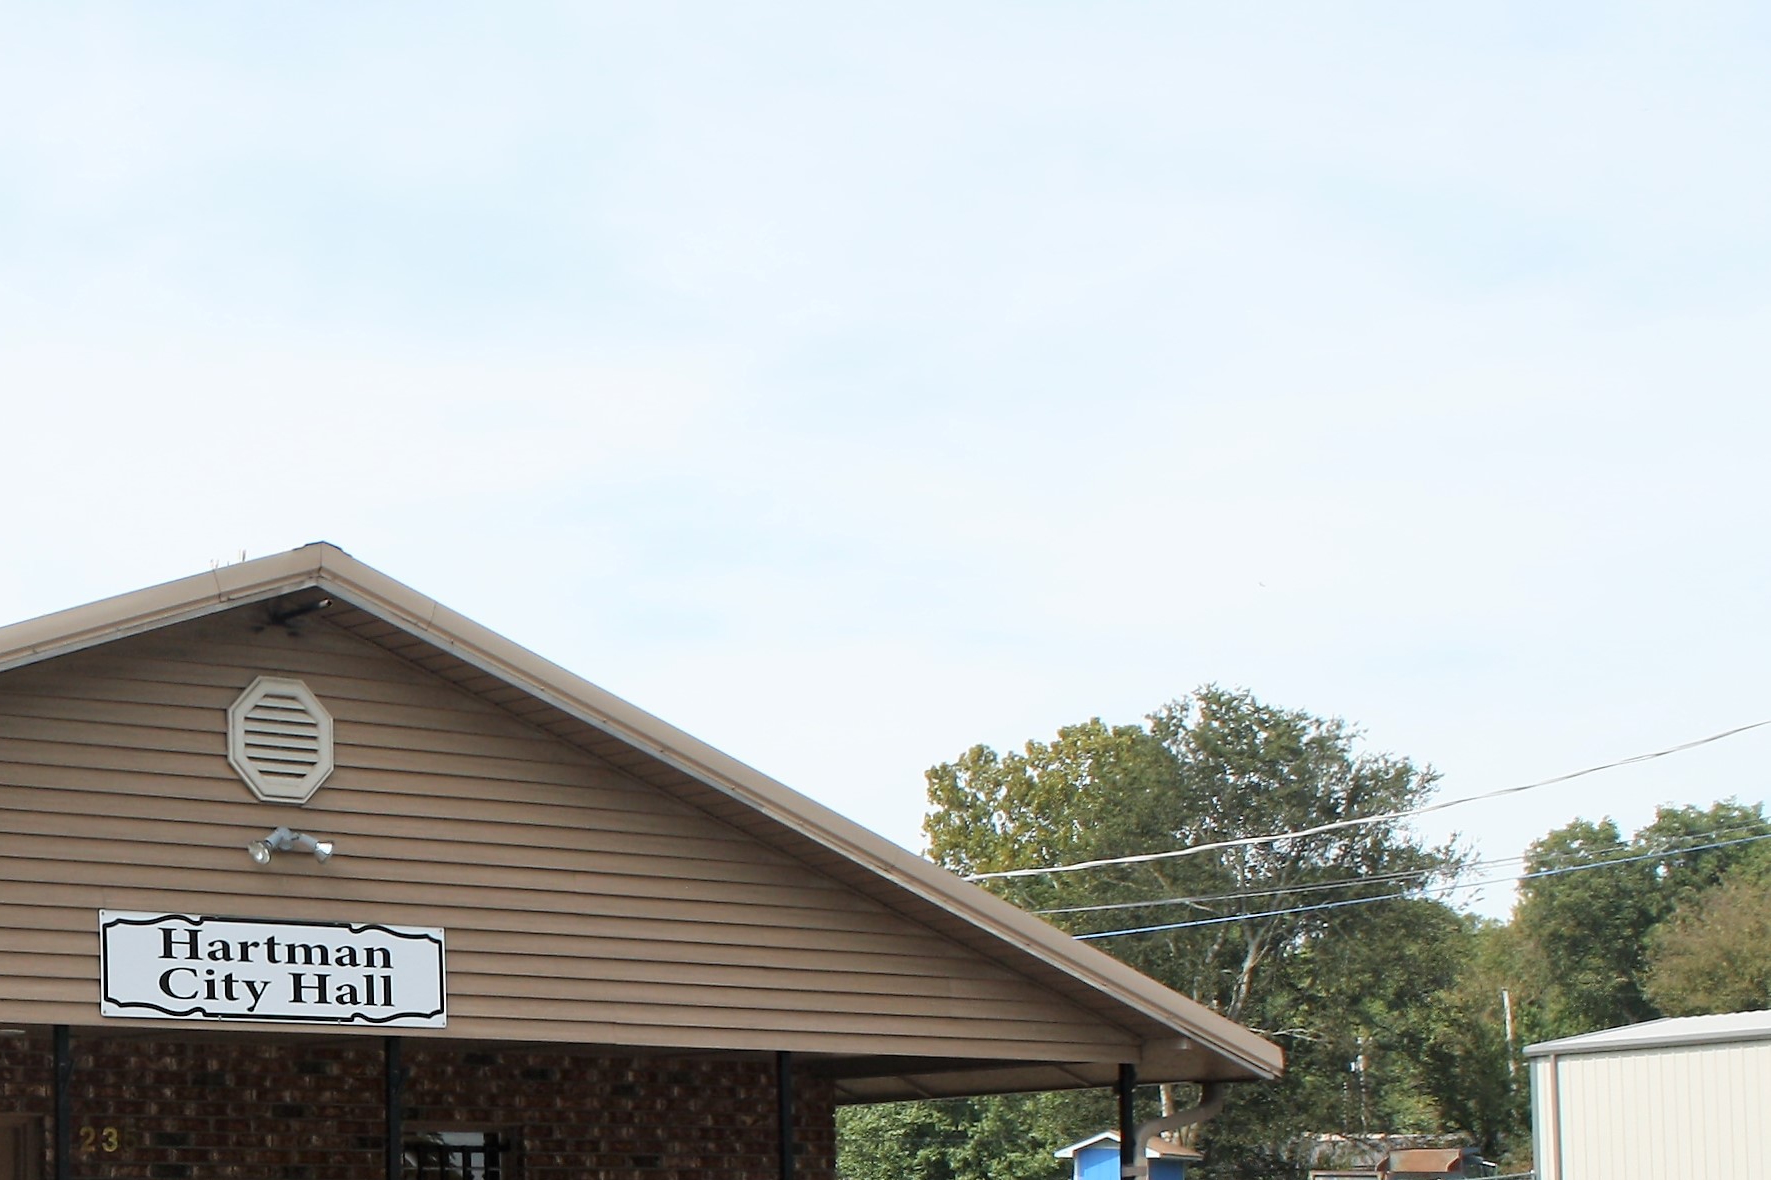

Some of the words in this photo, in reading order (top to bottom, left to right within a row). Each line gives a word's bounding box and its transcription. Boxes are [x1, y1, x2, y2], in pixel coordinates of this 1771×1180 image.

[158, 927, 394, 969] Hartman
[159, 967, 272, 1012] City
[288, 972, 395, 1007] Hall
